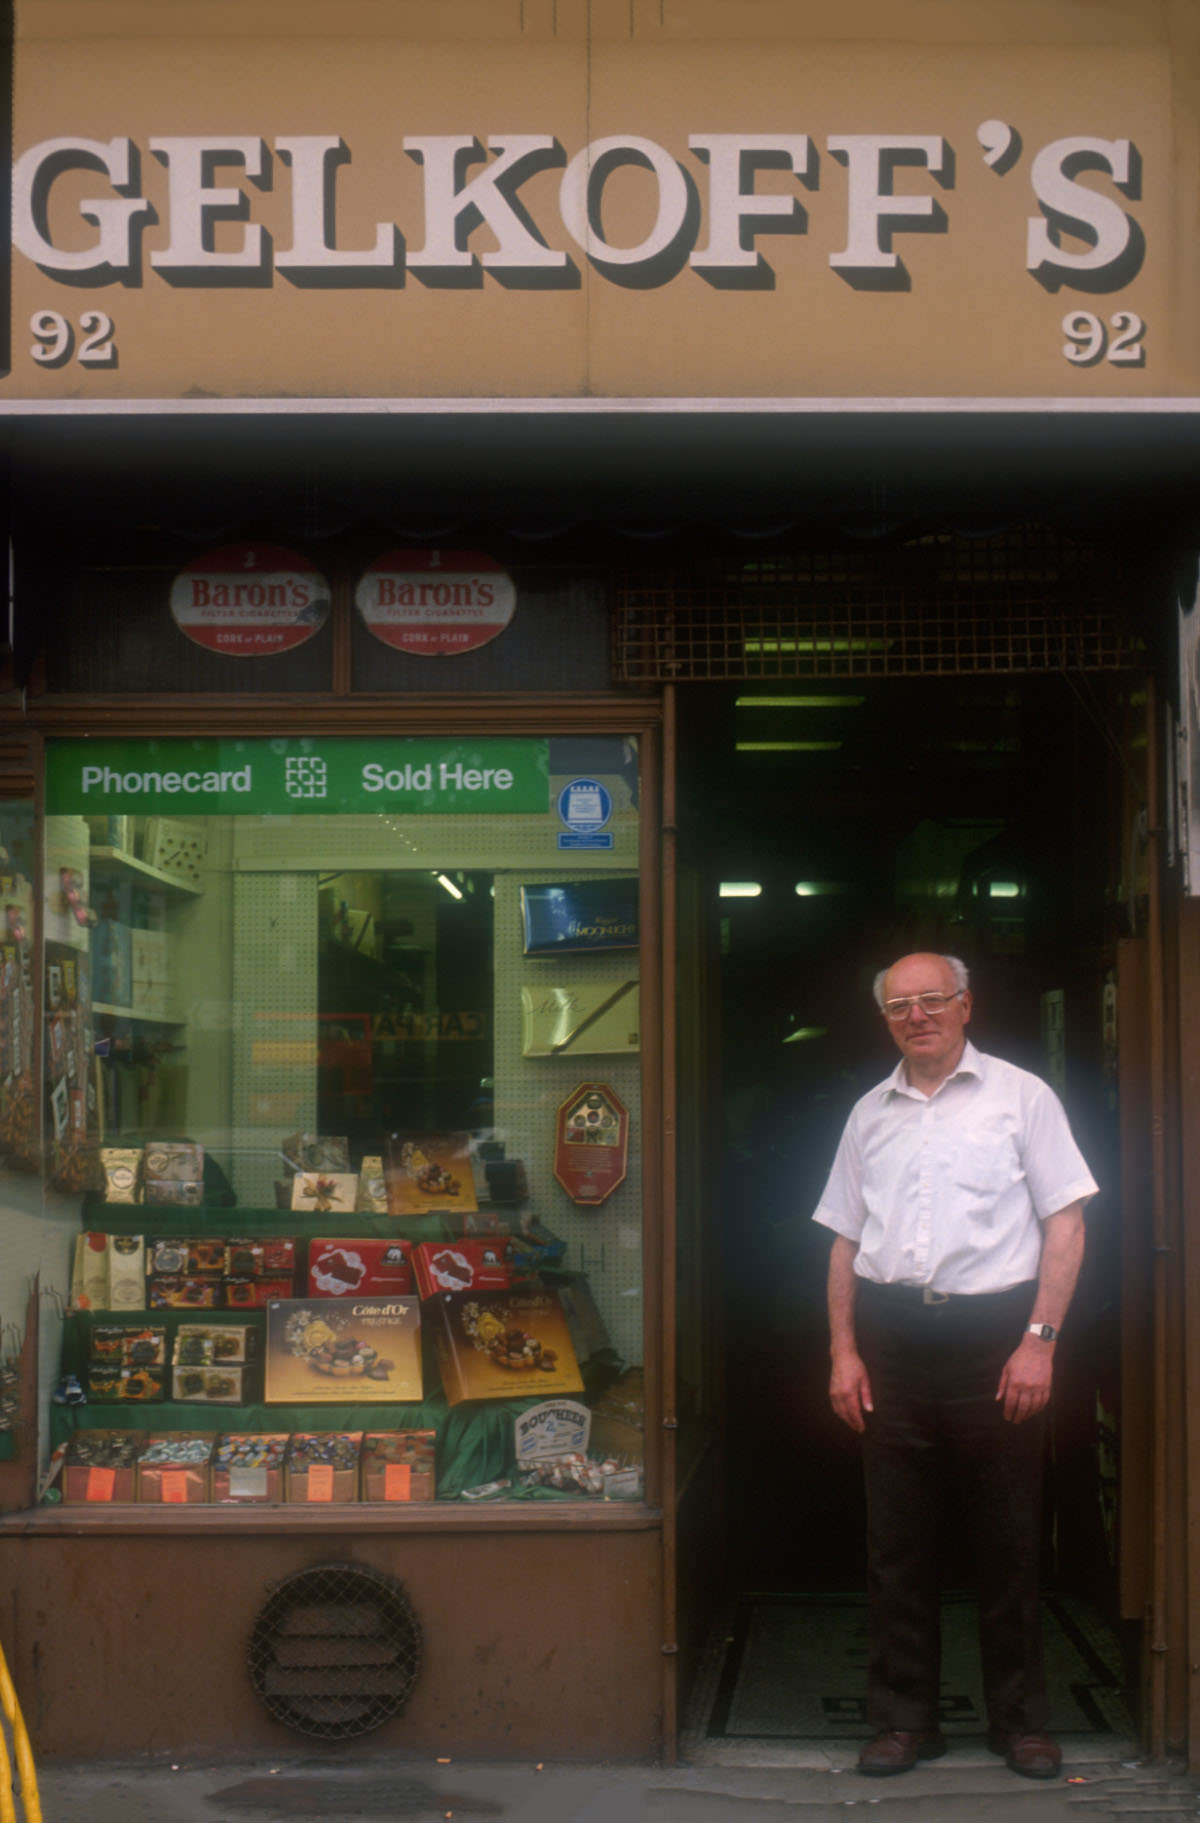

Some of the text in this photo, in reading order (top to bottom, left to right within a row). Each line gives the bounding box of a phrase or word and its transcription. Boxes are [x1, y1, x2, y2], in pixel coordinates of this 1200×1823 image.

[11, 119, 1146, 294] GELKOFF'S
[29, 309, 118, 369] 92
[1061, 309, 1146, 368] 92
[191, 578, 310, 608] Baron's
[376, 577, 495, 607] Baron's
[81, 765, 251, 793] Phonecard
[362, 763, 513, 791] Sold Here
